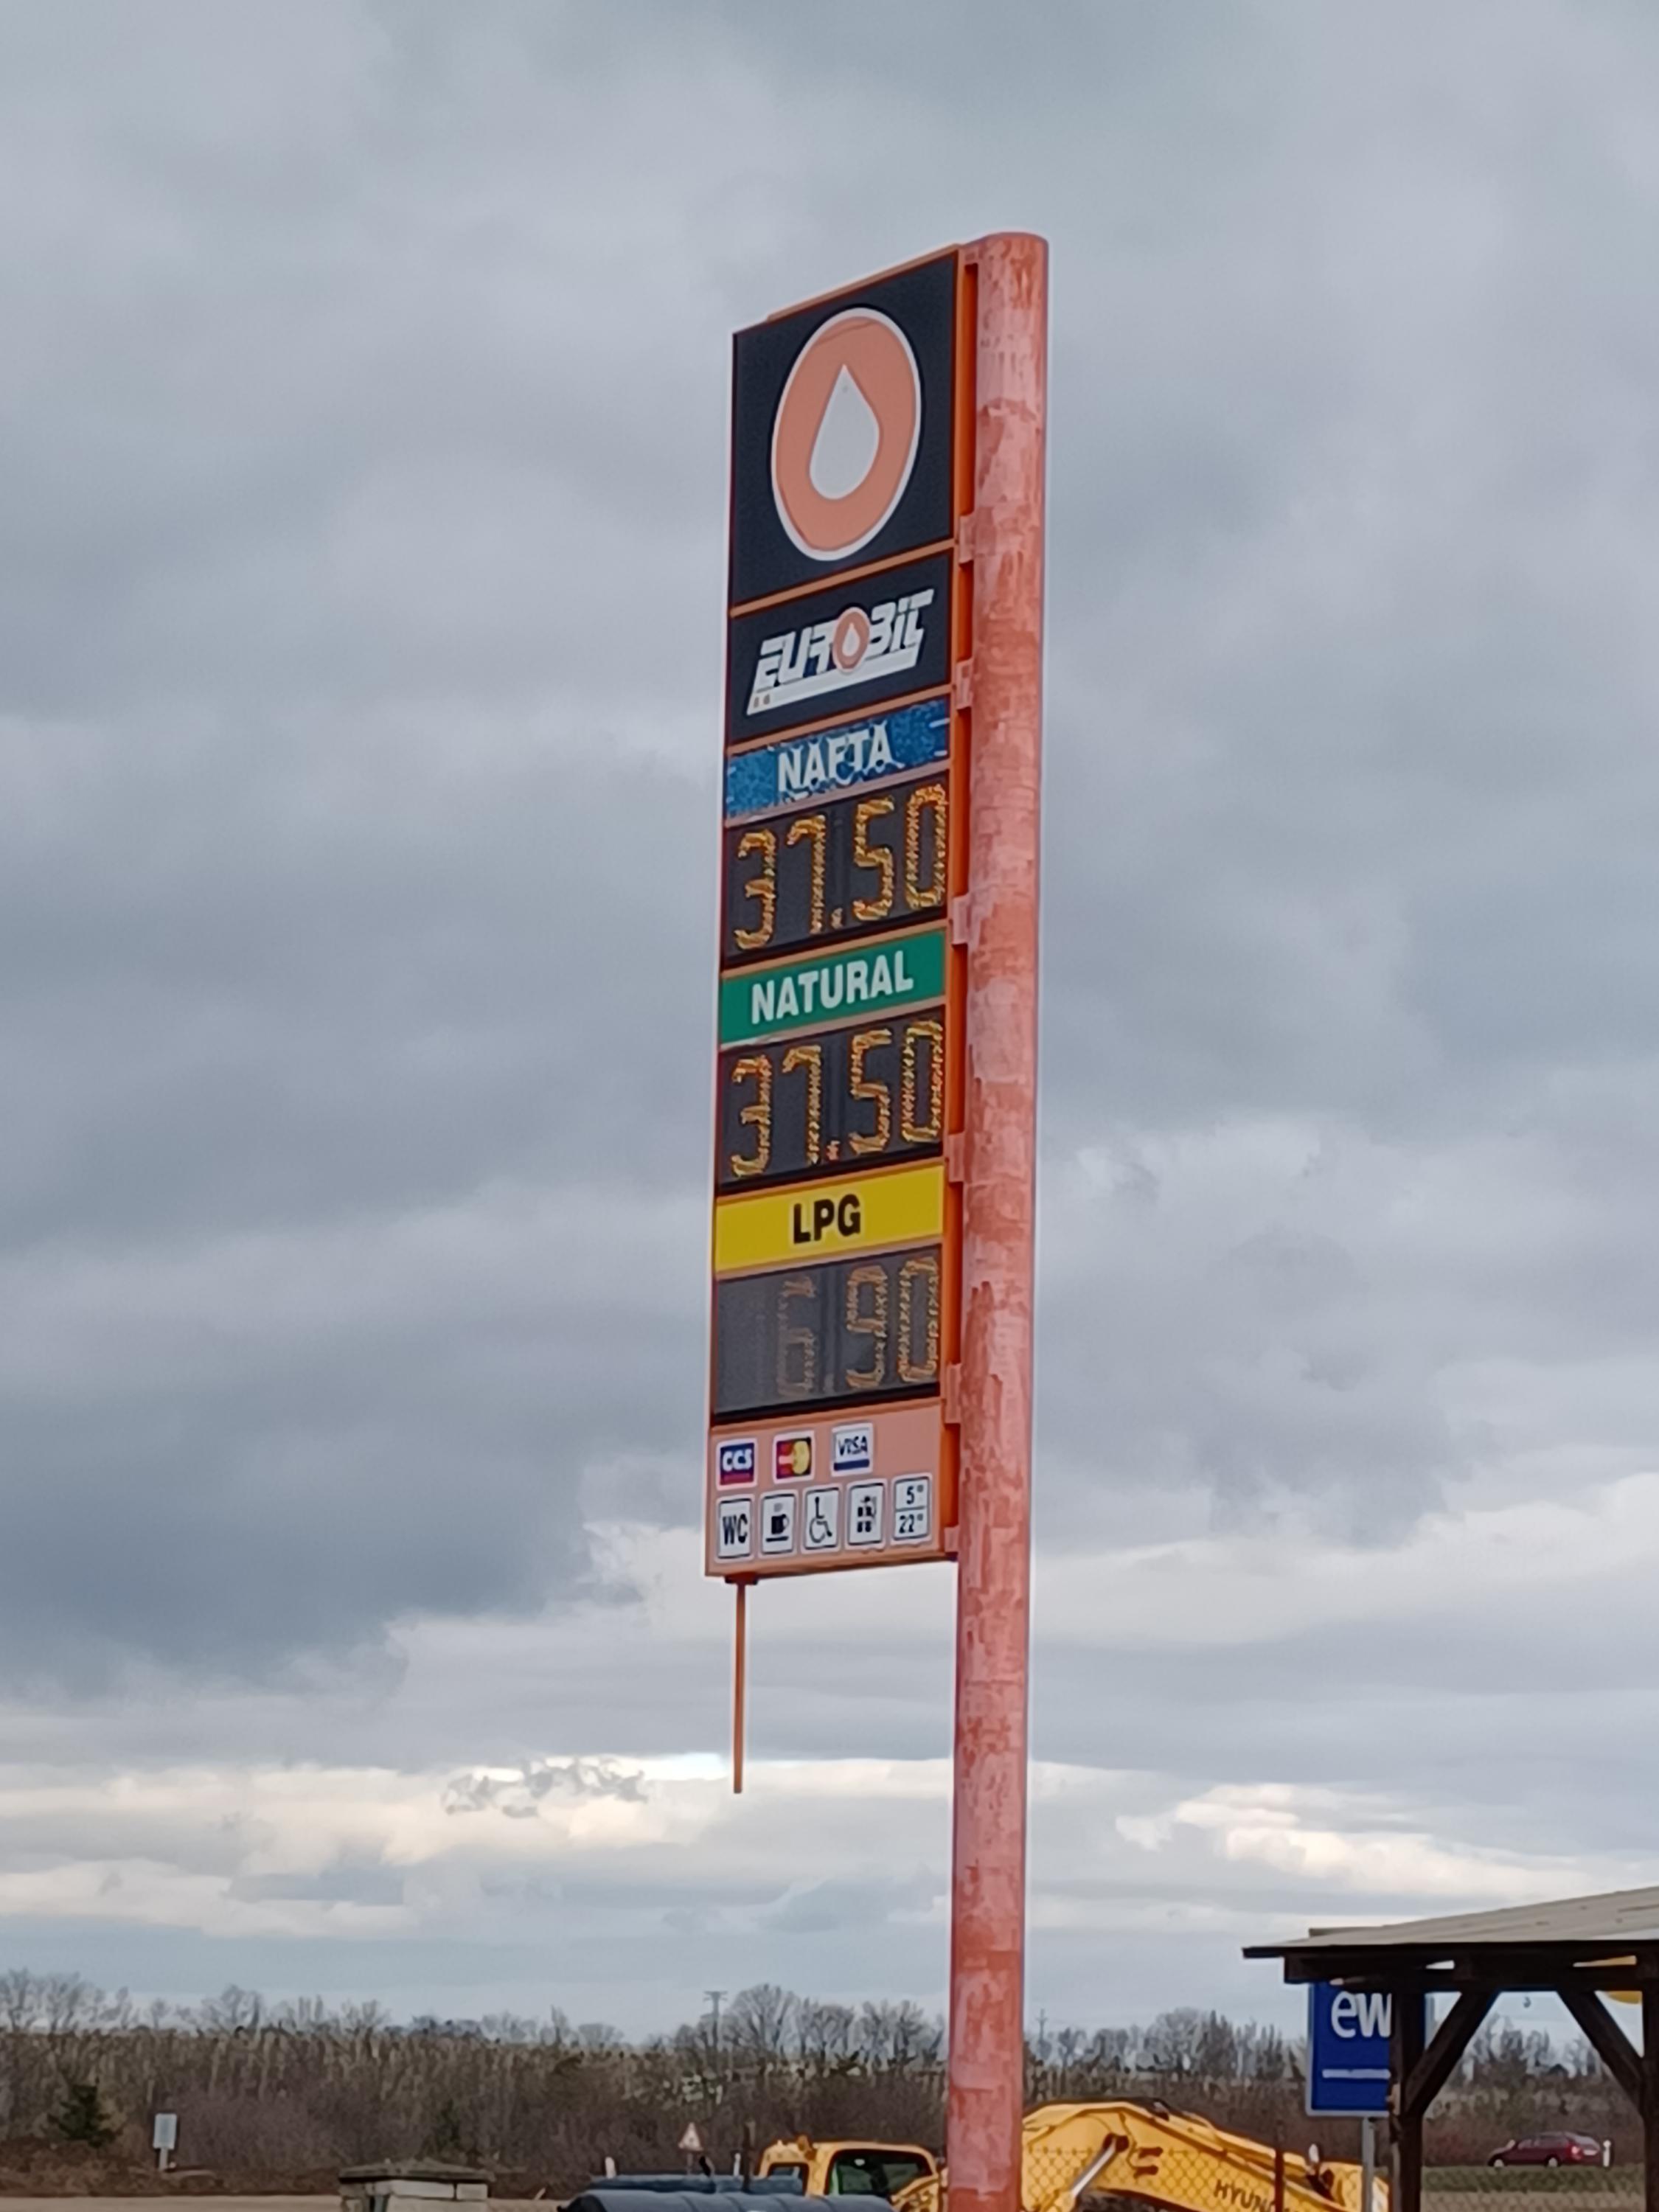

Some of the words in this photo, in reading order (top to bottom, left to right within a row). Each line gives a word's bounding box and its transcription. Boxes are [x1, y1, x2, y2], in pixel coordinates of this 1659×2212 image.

[777, 721, 895, 795] NAFTA
[733, 784, 947, 950] 37.50
[751, 950, 914, 1025] NATURAL
[731, 1020, 944, 1178] 37.50
[793, 1193, 861, 1244] LPG
[722, 1448, 753, 1472] CCS
[838, 1436, 869, 1457] VISA
[722, 1513, 748, 1545] WC
